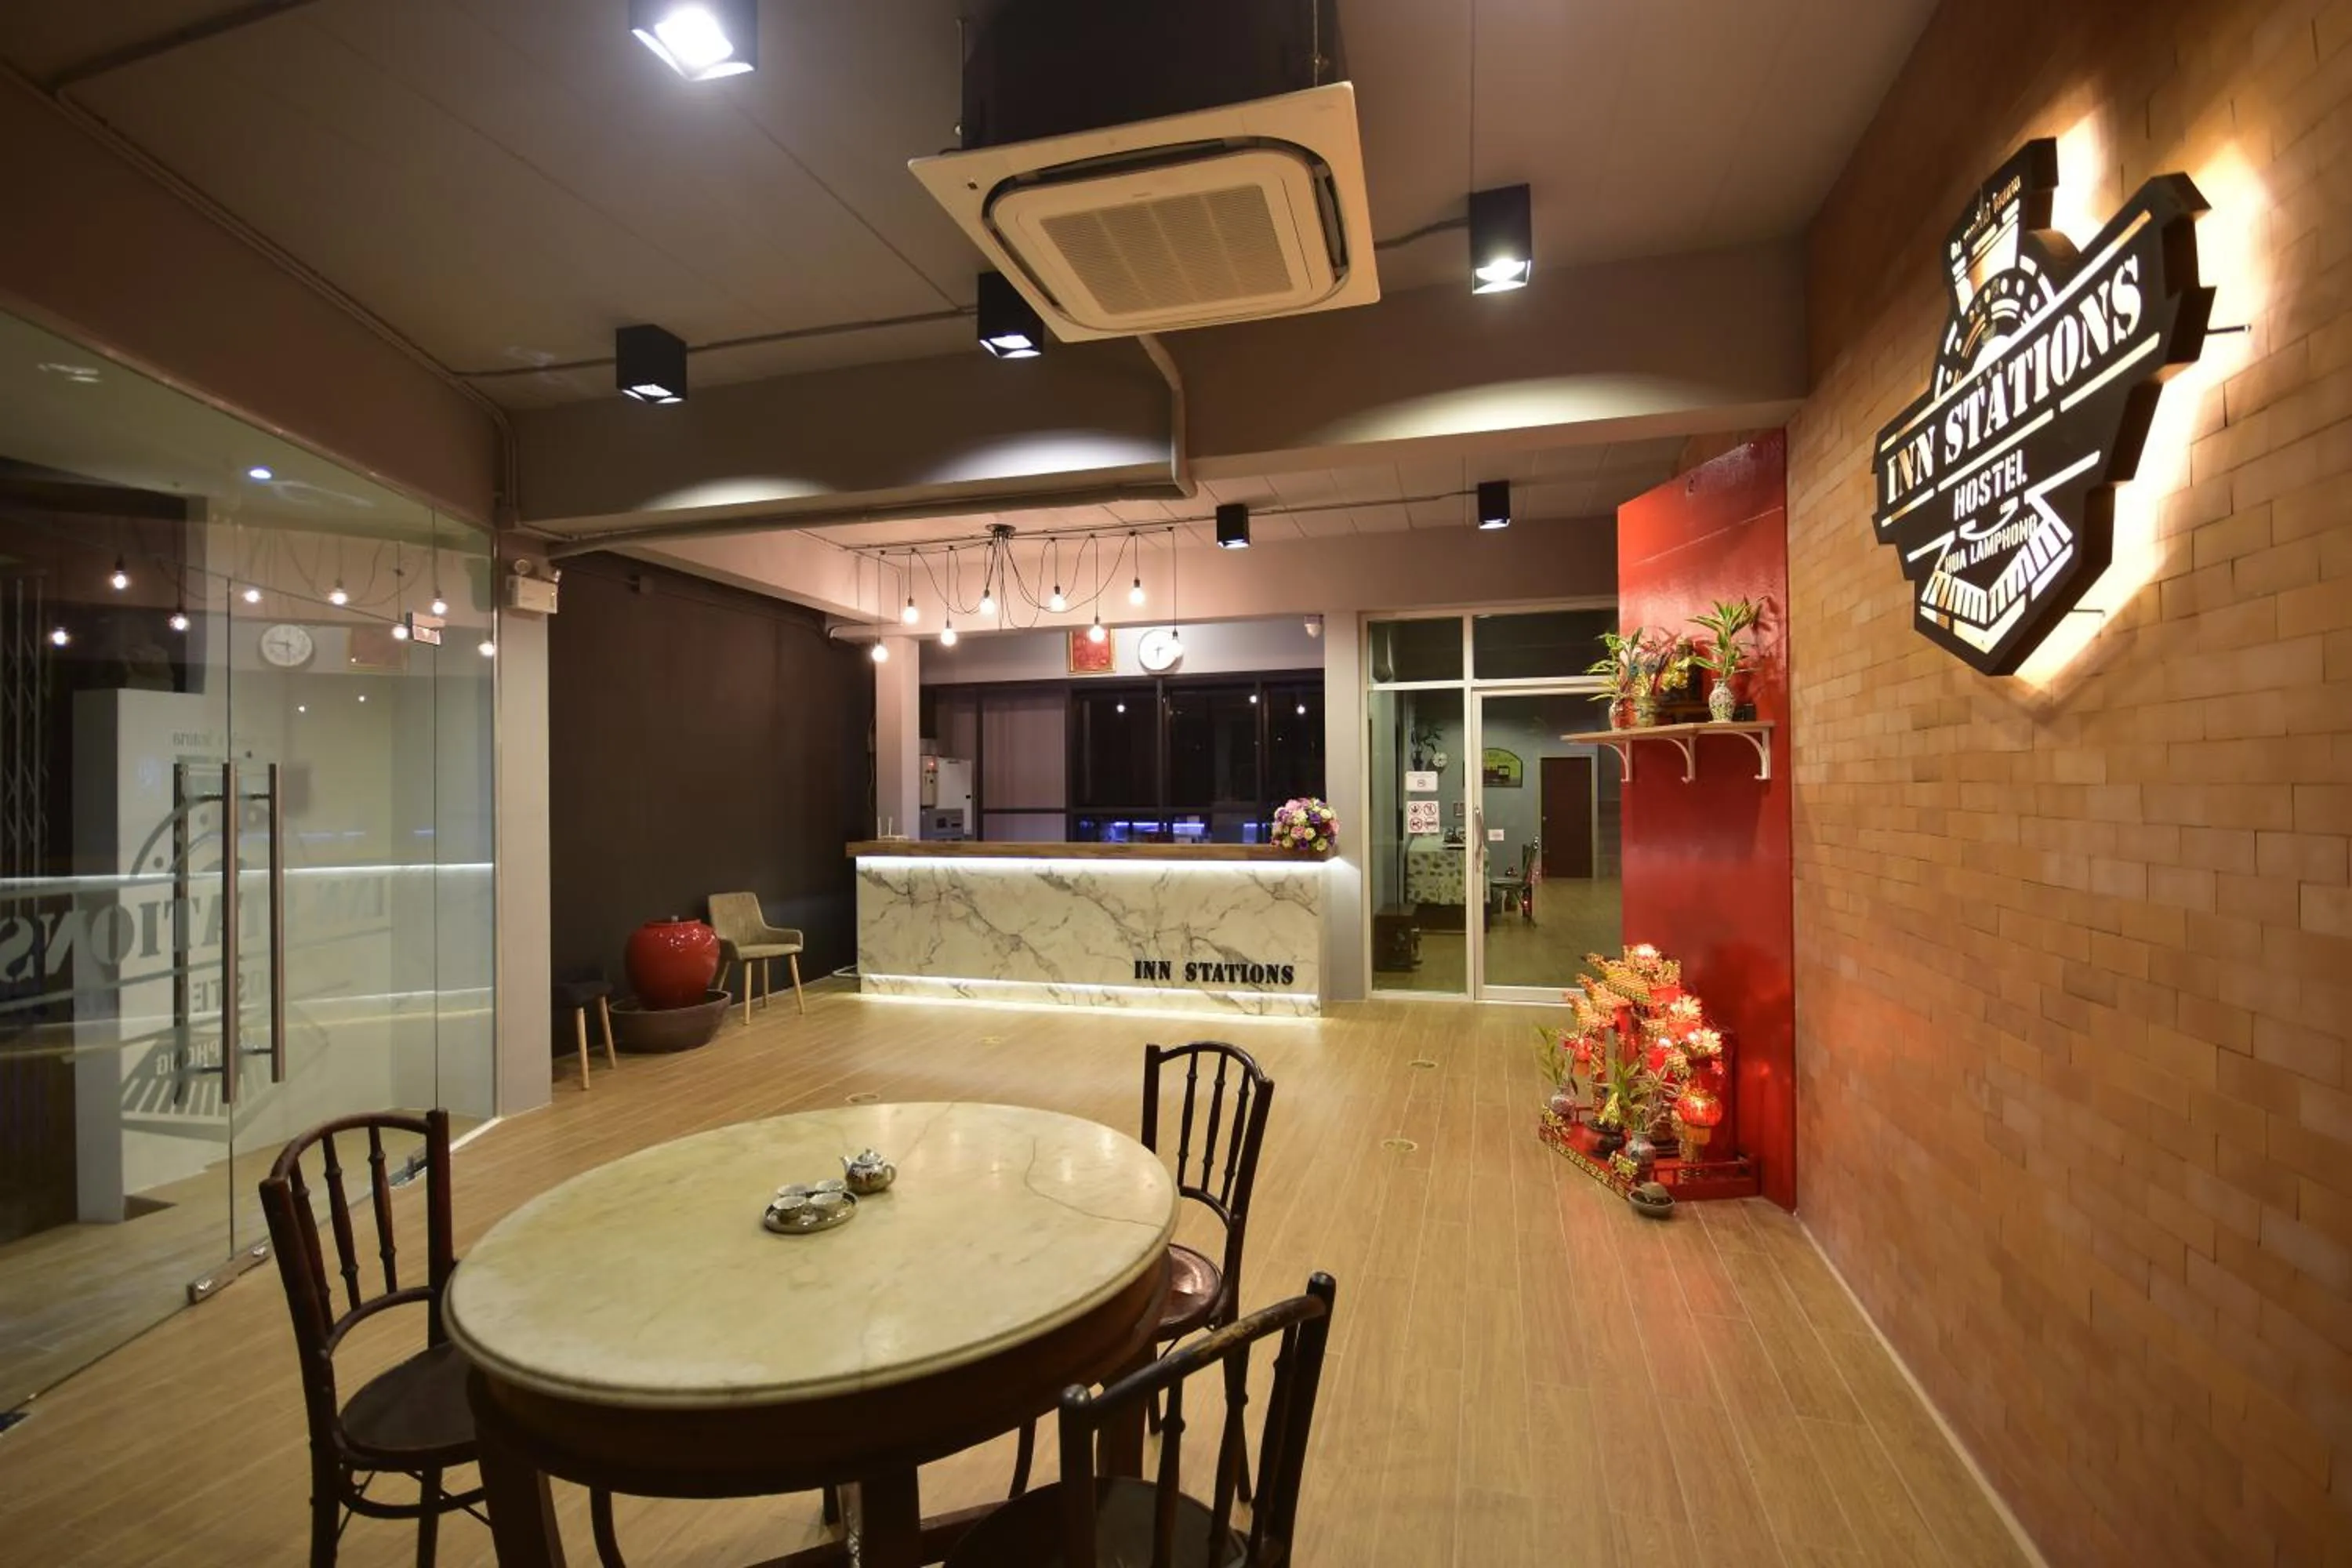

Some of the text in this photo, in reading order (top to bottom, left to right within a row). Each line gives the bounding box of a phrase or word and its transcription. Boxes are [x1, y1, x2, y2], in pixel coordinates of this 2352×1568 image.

[1886, 253, 2142, 505] INN STATIONS
[1954, 448, 2028, 521] HOSTEL
[1945, 548, 1967, 575] HUA
[1134, 960, 1294, 985] INN STATIONS
